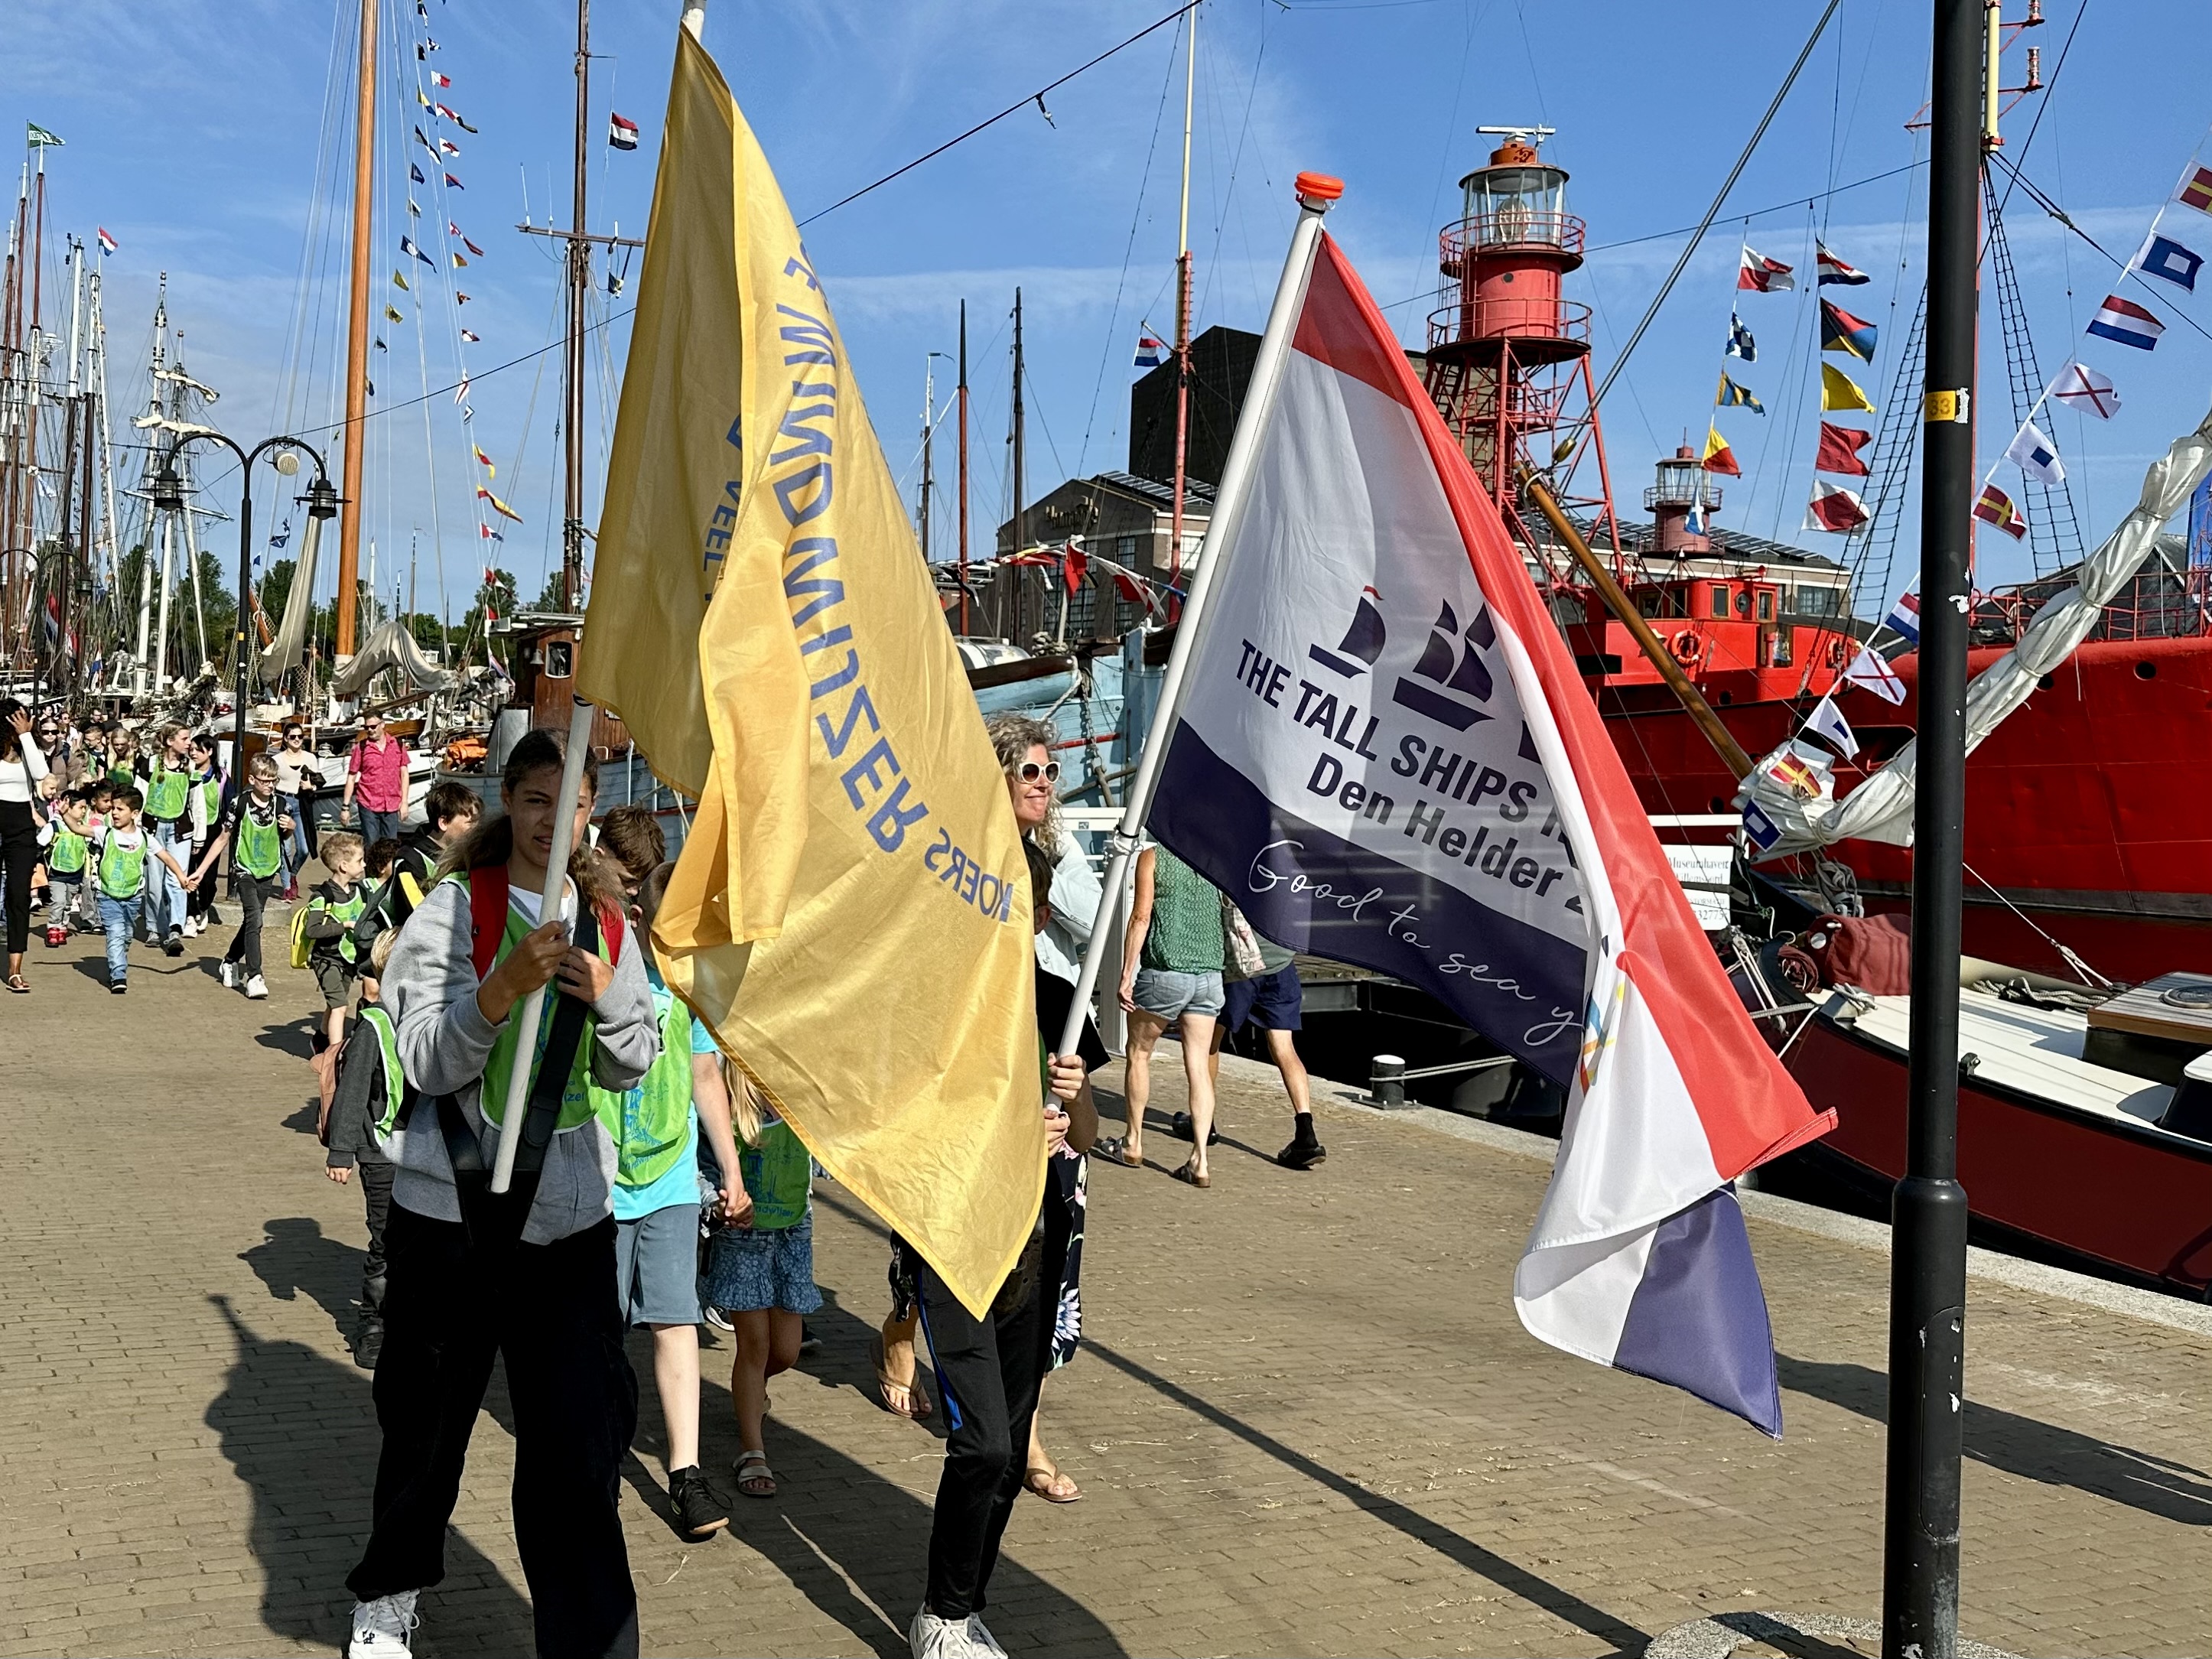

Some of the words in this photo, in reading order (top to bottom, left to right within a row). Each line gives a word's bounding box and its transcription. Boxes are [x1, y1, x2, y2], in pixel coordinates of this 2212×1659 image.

[1236, 638, 1290, 709] THE
[1294, 679, 1380, 762] TALL
[1390, 734, 1537, 824] SHIPS
[1306, 752, 1395, 825] Den
[1403, 799, 1563, 898] Helder
[1248, 839, 1384, 922] Good
[1387, 903, 1431, 949] to
[1438, 951, 1537, 1002] sea
